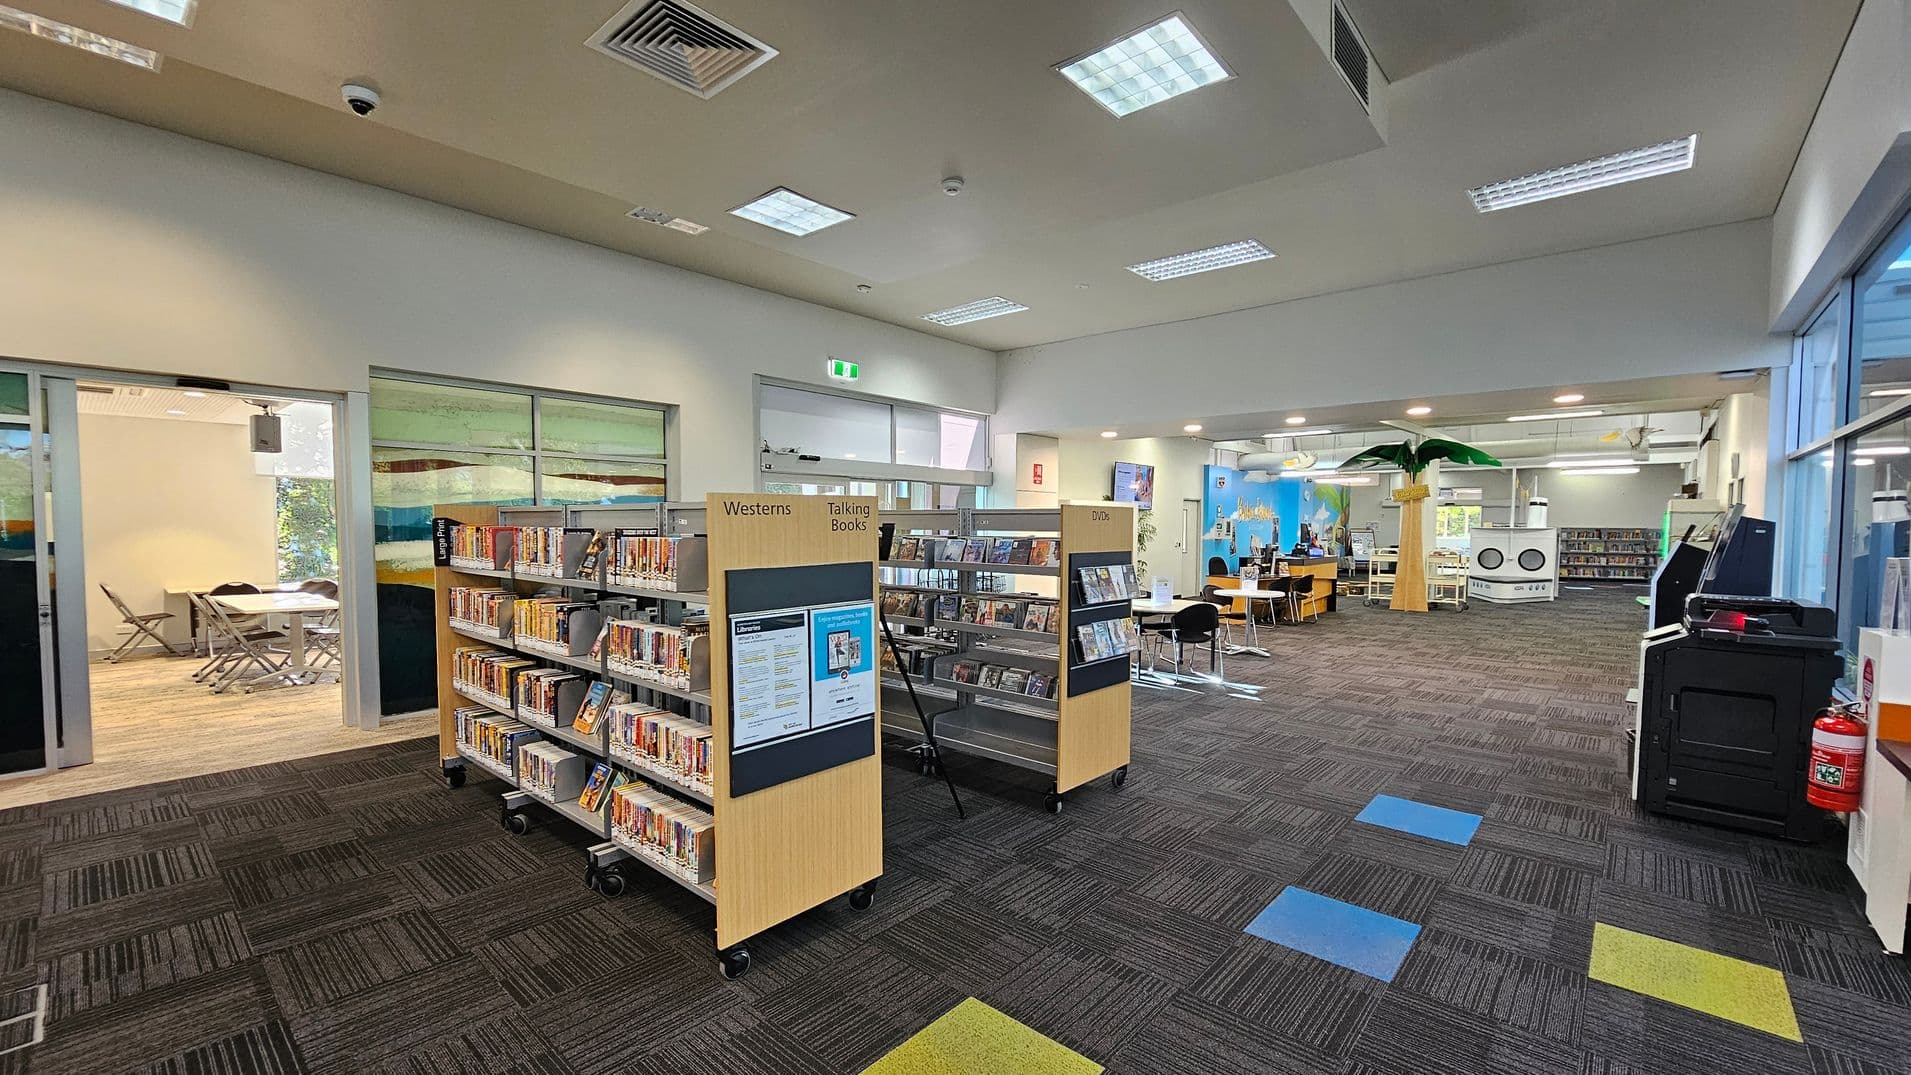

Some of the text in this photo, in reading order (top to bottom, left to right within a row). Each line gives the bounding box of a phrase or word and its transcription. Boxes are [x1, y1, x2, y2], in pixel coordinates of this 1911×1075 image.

[723, 501, 792, 516] Westerns
[827, 502, 870, 518] Talking
[1091, 510, 1111, 521] DVDs
[831, 518, 867, 532] Books
[436, 519, 448, 560] Large Print
[736, 624, 762, 633] Libraries
